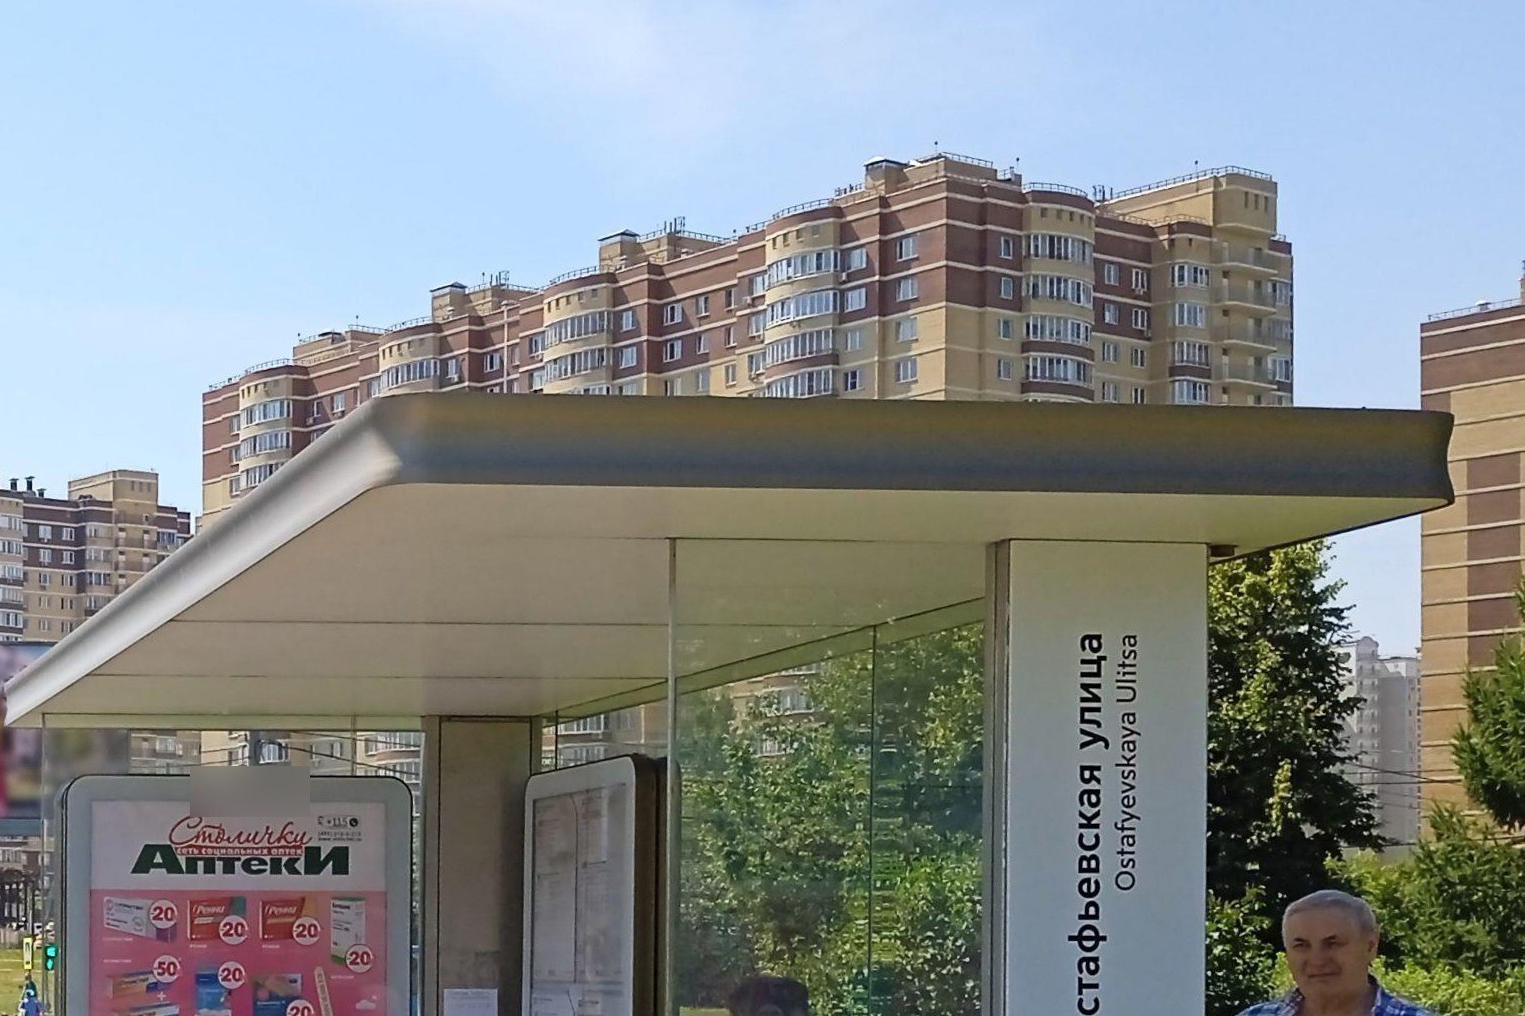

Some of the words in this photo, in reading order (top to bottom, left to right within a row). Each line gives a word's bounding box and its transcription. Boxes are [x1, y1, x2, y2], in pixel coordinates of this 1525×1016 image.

[1079, 633, 1109, 750] улица
[1115, 634, 1139, 703] Ulitsa
[169, 815, 313, 845] Столички
[1114, 711, 1141, 891] Ostafyevskaya
